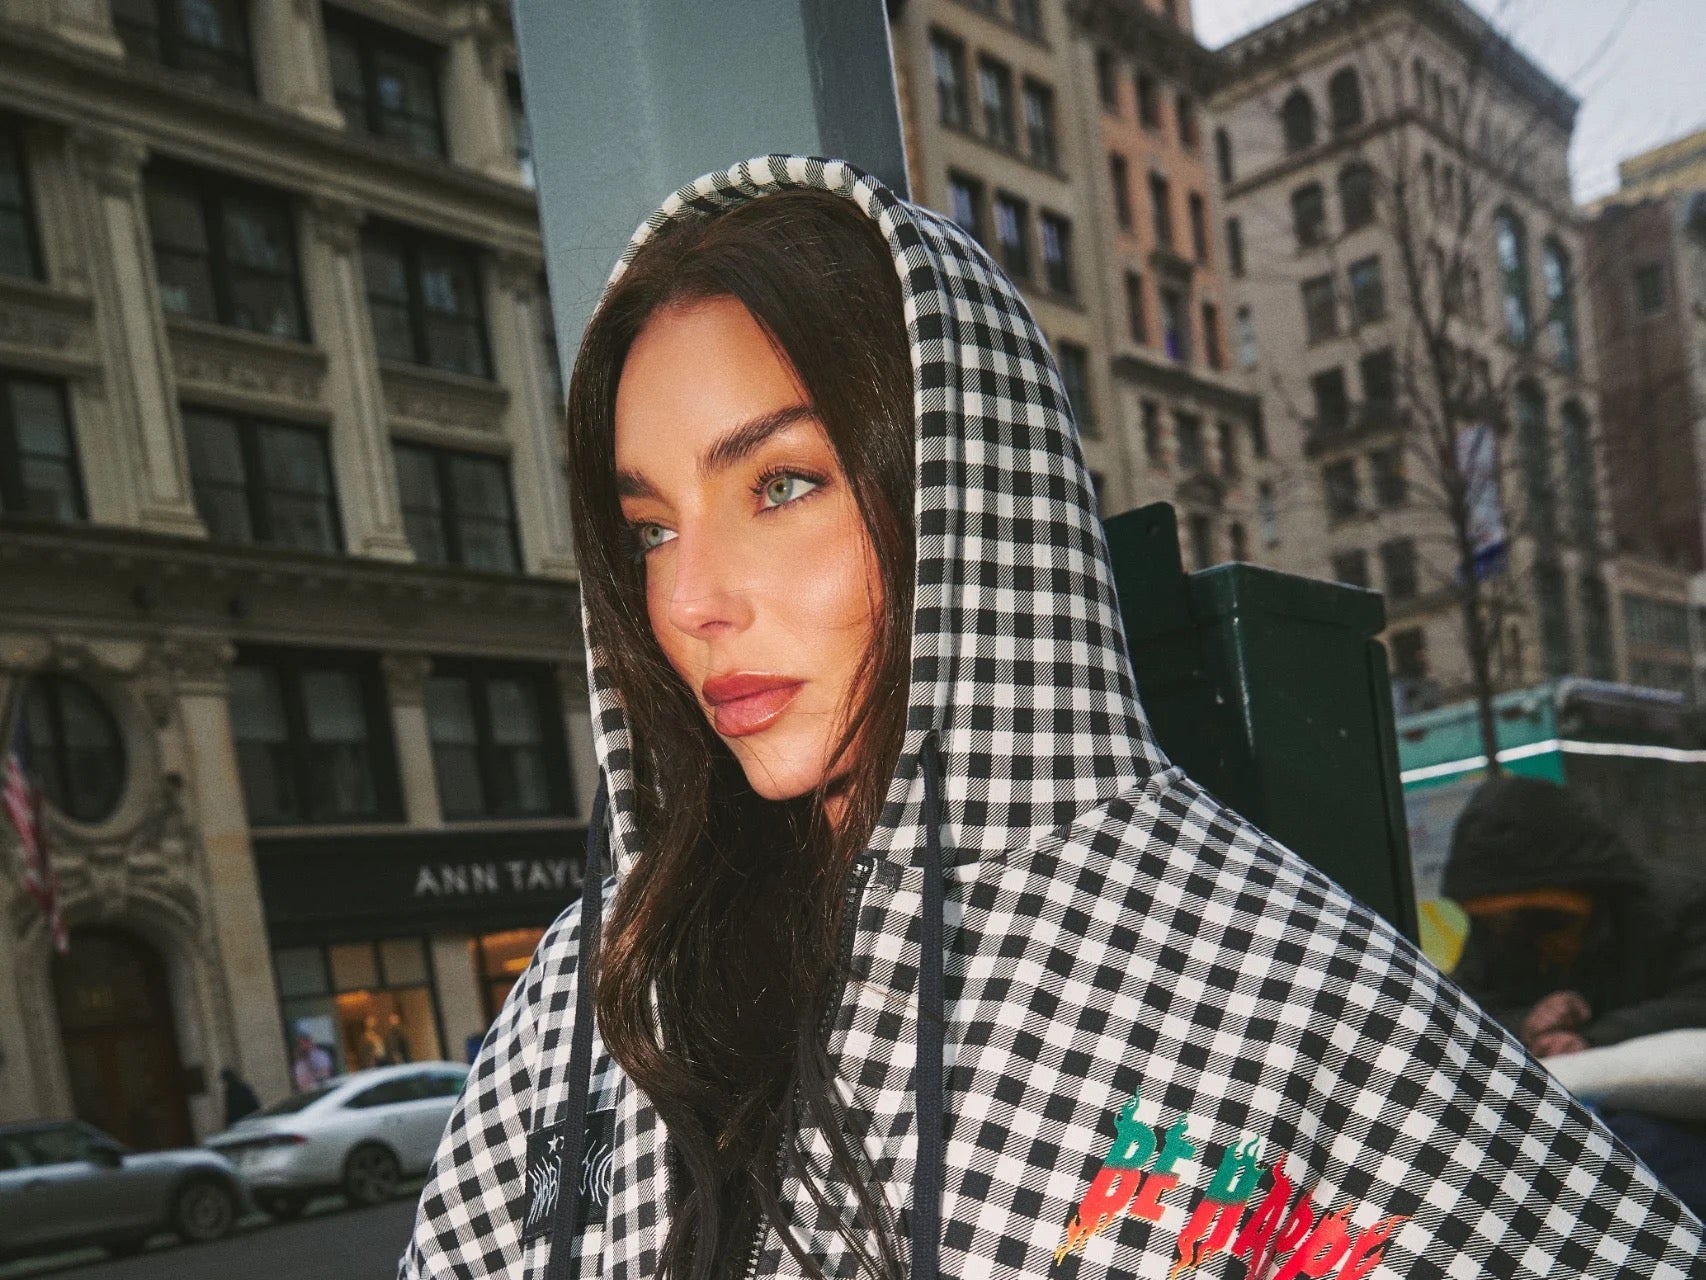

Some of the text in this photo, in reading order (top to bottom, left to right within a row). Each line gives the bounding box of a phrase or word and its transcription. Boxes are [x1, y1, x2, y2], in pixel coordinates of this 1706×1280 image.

[414, 858, 608, 896] ANN TAYL
[1054, 1085, 1196, 1267] BE
